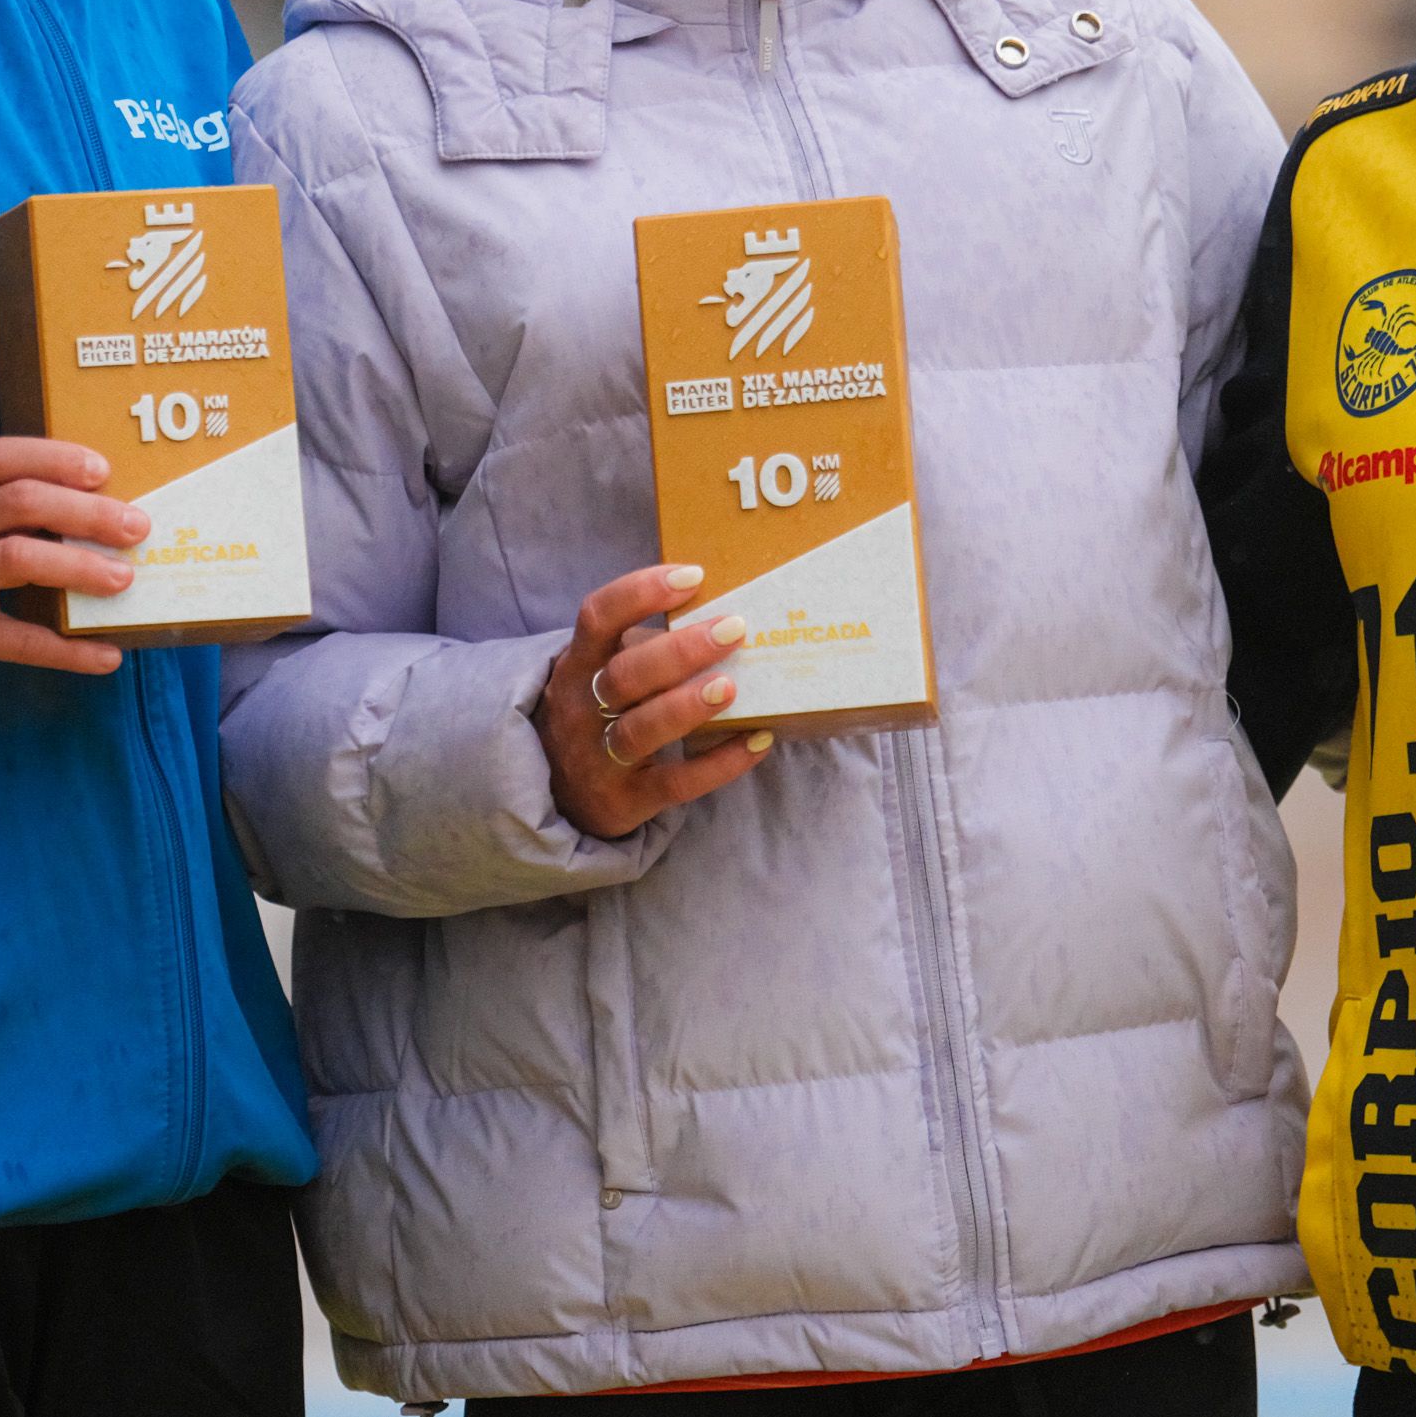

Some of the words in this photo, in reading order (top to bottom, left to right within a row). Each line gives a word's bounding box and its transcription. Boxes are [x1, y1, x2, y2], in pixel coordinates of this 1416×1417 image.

[114, 99, 230, 152] Piélag
[1358, 285, 1380, 304] CLUB
[1382, 278, 1394, 289] DE
[81, 338, 131, 351] MANN
[143, 333, 174, 348] XIX
[178, 325, 268, 346] MARATÓN
[82, 351, 132, 363] FILTER
[143, 348, 169, 365] DE
[170, 343, 270, 363] ZARAGOZA
[670, 381, 728, 397] MANN
[741, 373, 777, 392] XIX
[782, 362, 883, 388] MARATÓN
[671, 396, 729, 411] FILTER
[742, 390, 771, 409] DE
[773, 380, 887, 406] ZARAGOZA
[129, 392, 201, 443] 10
[203, 394, 229, 410] KM
[727, 453, 808, 510] 10
[811, 453, 840, 471] KM
[741, 621, 872, 650] LASIFICADA
